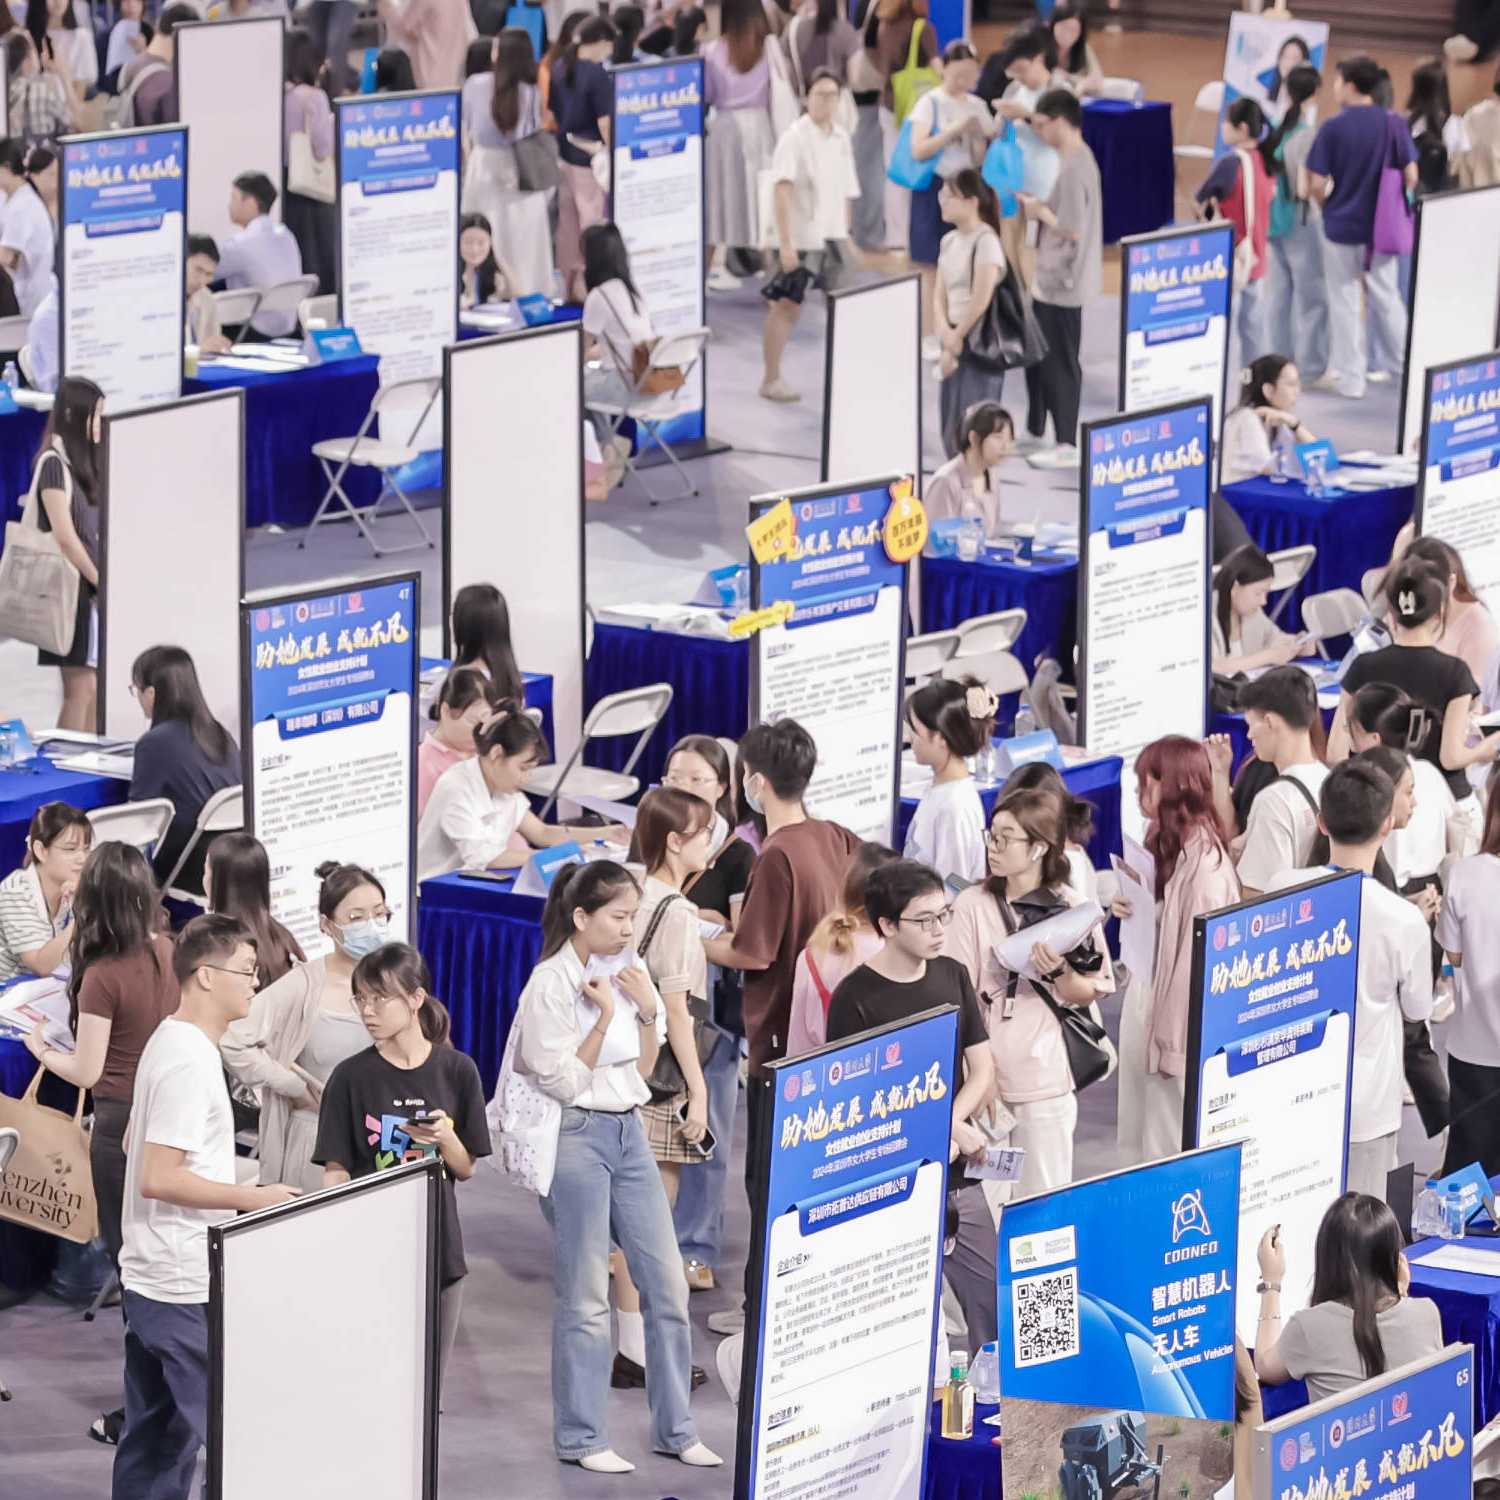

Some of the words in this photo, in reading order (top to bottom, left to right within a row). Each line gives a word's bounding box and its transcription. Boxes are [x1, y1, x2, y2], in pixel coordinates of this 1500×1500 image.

[399, 588, 410, 600] 47
[256, 632, 332, 670] 助她发展
[337, 611, 410, 654] 成就不凡
[1210, 947, 1282, 996] 助她发展
[1286, 919, 1352, 970] 成就不凡
[781, 1096, 864, 1151] 助她发展
[869, 1061, 947, 1119] 成就不凡
[825, 1119, 901, 1158] 女性就业创业支持计划
[1164, 1241, 1218, 1264] COONEO
[1152, 1270, 1231, 1310] 智慧机器人
[1152, 1312, 1176, 1327] Smart
[1178, 1304, 1206, 1319] Robots
[1152, 1325, 1200, 1358] 无人车
[1151, 1353, 1201, 1376] Autonomous
[1203, 1344, 1234, 1360] Vehicles
[1456, 1369, 1468, 1387] 65
[1378, 1411, 1465, 1485] 成就不凡
